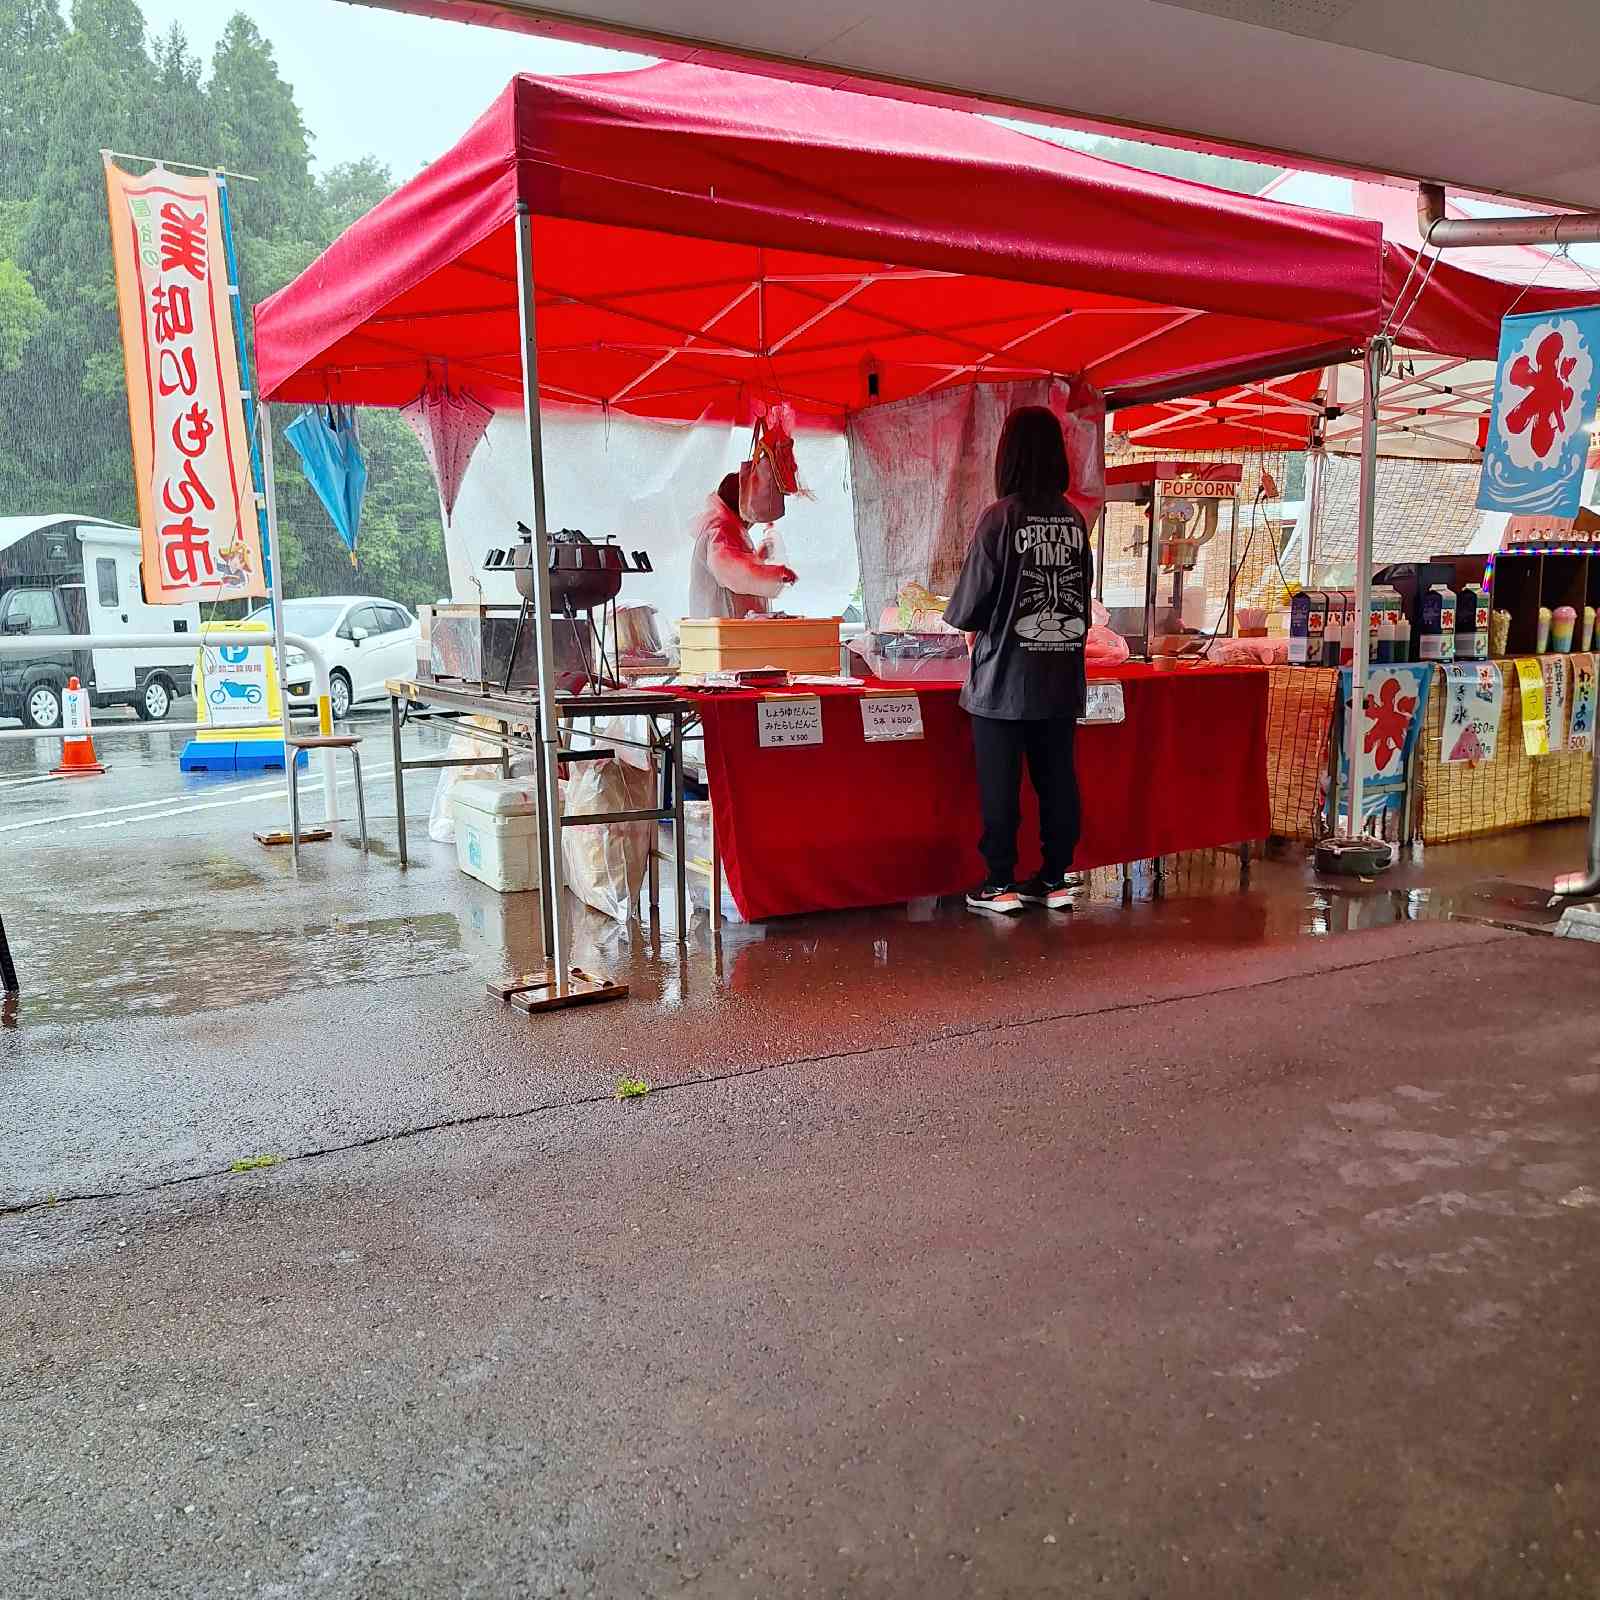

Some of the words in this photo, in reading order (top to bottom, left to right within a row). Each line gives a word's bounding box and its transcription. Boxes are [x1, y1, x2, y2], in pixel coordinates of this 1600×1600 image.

[1163, 481, 1235, 496] POPCORN
[1033, 542, 1072, 566] TIME
[1573, 668, 1593, 732] わたあめ
[766, 706, 817, 718] しょうゆだんご
[868, 703, 914, 714] だんごミックス
[765, 718, 818, 730] みたらしだんご
[891, 716, 913, 724] ¥500
